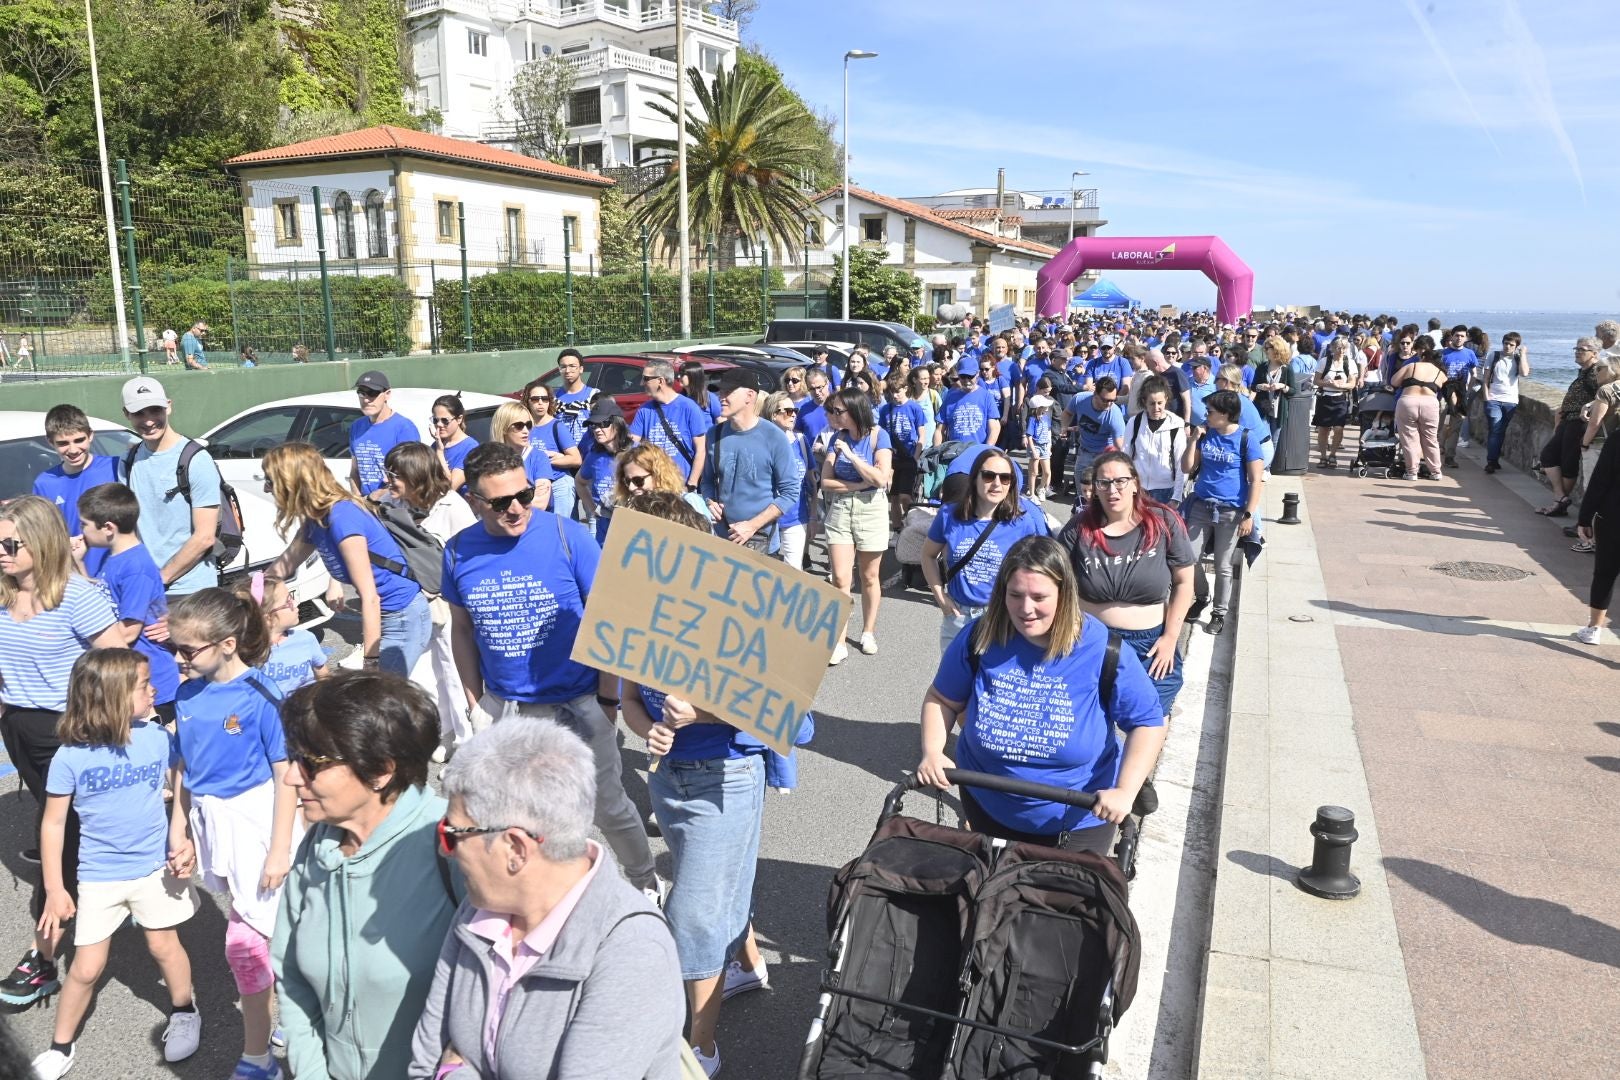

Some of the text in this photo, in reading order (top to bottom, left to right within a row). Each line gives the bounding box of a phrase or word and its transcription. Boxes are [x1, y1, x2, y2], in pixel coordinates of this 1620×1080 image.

[1111, 251, 1154, 260] LABORAL
[502, 575, 533, 583] MUCHOS
[621, 528, 841, 650] AUTISMOA
[497, 596, 526, 604] MATICES
[529, 593, 554, 601] URDIN
[536, 604, 558, 613] URDIN
[501, 623, 530, 631] MATICES
[533, 617, 556, 627] URDIN
[503, 616, 525, 624] ANITZ
[496, 637, 522, 645] MUCHOS
[523, 632, 549, 642] MATICES
[516, 628, 539, 637] ANITZ
[649, 592, 768, 674] EZ DA
[522, 640, 544, 649] URDIN
[1008, 668, 1063, 683] AZUL MUCHOS
[1033, 665, 1045, 673] UN
[588, 620, 807, 747] SENDATZEN
[998, 673, 1028, 686] MATICES
[1031, 681, 1051, 689] URDIN
[992, 679, 1014, 690] URDIN
[1016, 686, 1037, 695] ANITZ
[1051, 690, 1070, 699] AZUL
[1019, 695, 1046, 703] MATICES
[1049, 697, 1072, 707] URDIN
[1017, 702, 1040, 710] ANITZ
[1055, 706, 1074, 715] AZUL
[989, 710, 1010, 721] URDIN
[1012, 717, 1037, 726] ANITZ
[1039, 720, 1050, 729] UN
[1053, 723, 1073, 731] AZUL
[1011, 709, 1043, 719] MATICES
[1050, 714, 1074, 722] URDIN
[975, 721, 1065, 747] BAT URDIN ANITZ UN
[1007, 723, 1040, 734] MATICES
[1044, 730, 1069, 738] URDIN
[977, 732, 1056, 754] AZUL MUCHOS MATICES
[981, 740, 1004, 752] URDIN
[1002, 754, 1027, 762] ANITZ
[79, 760, 162, 793] Bling
